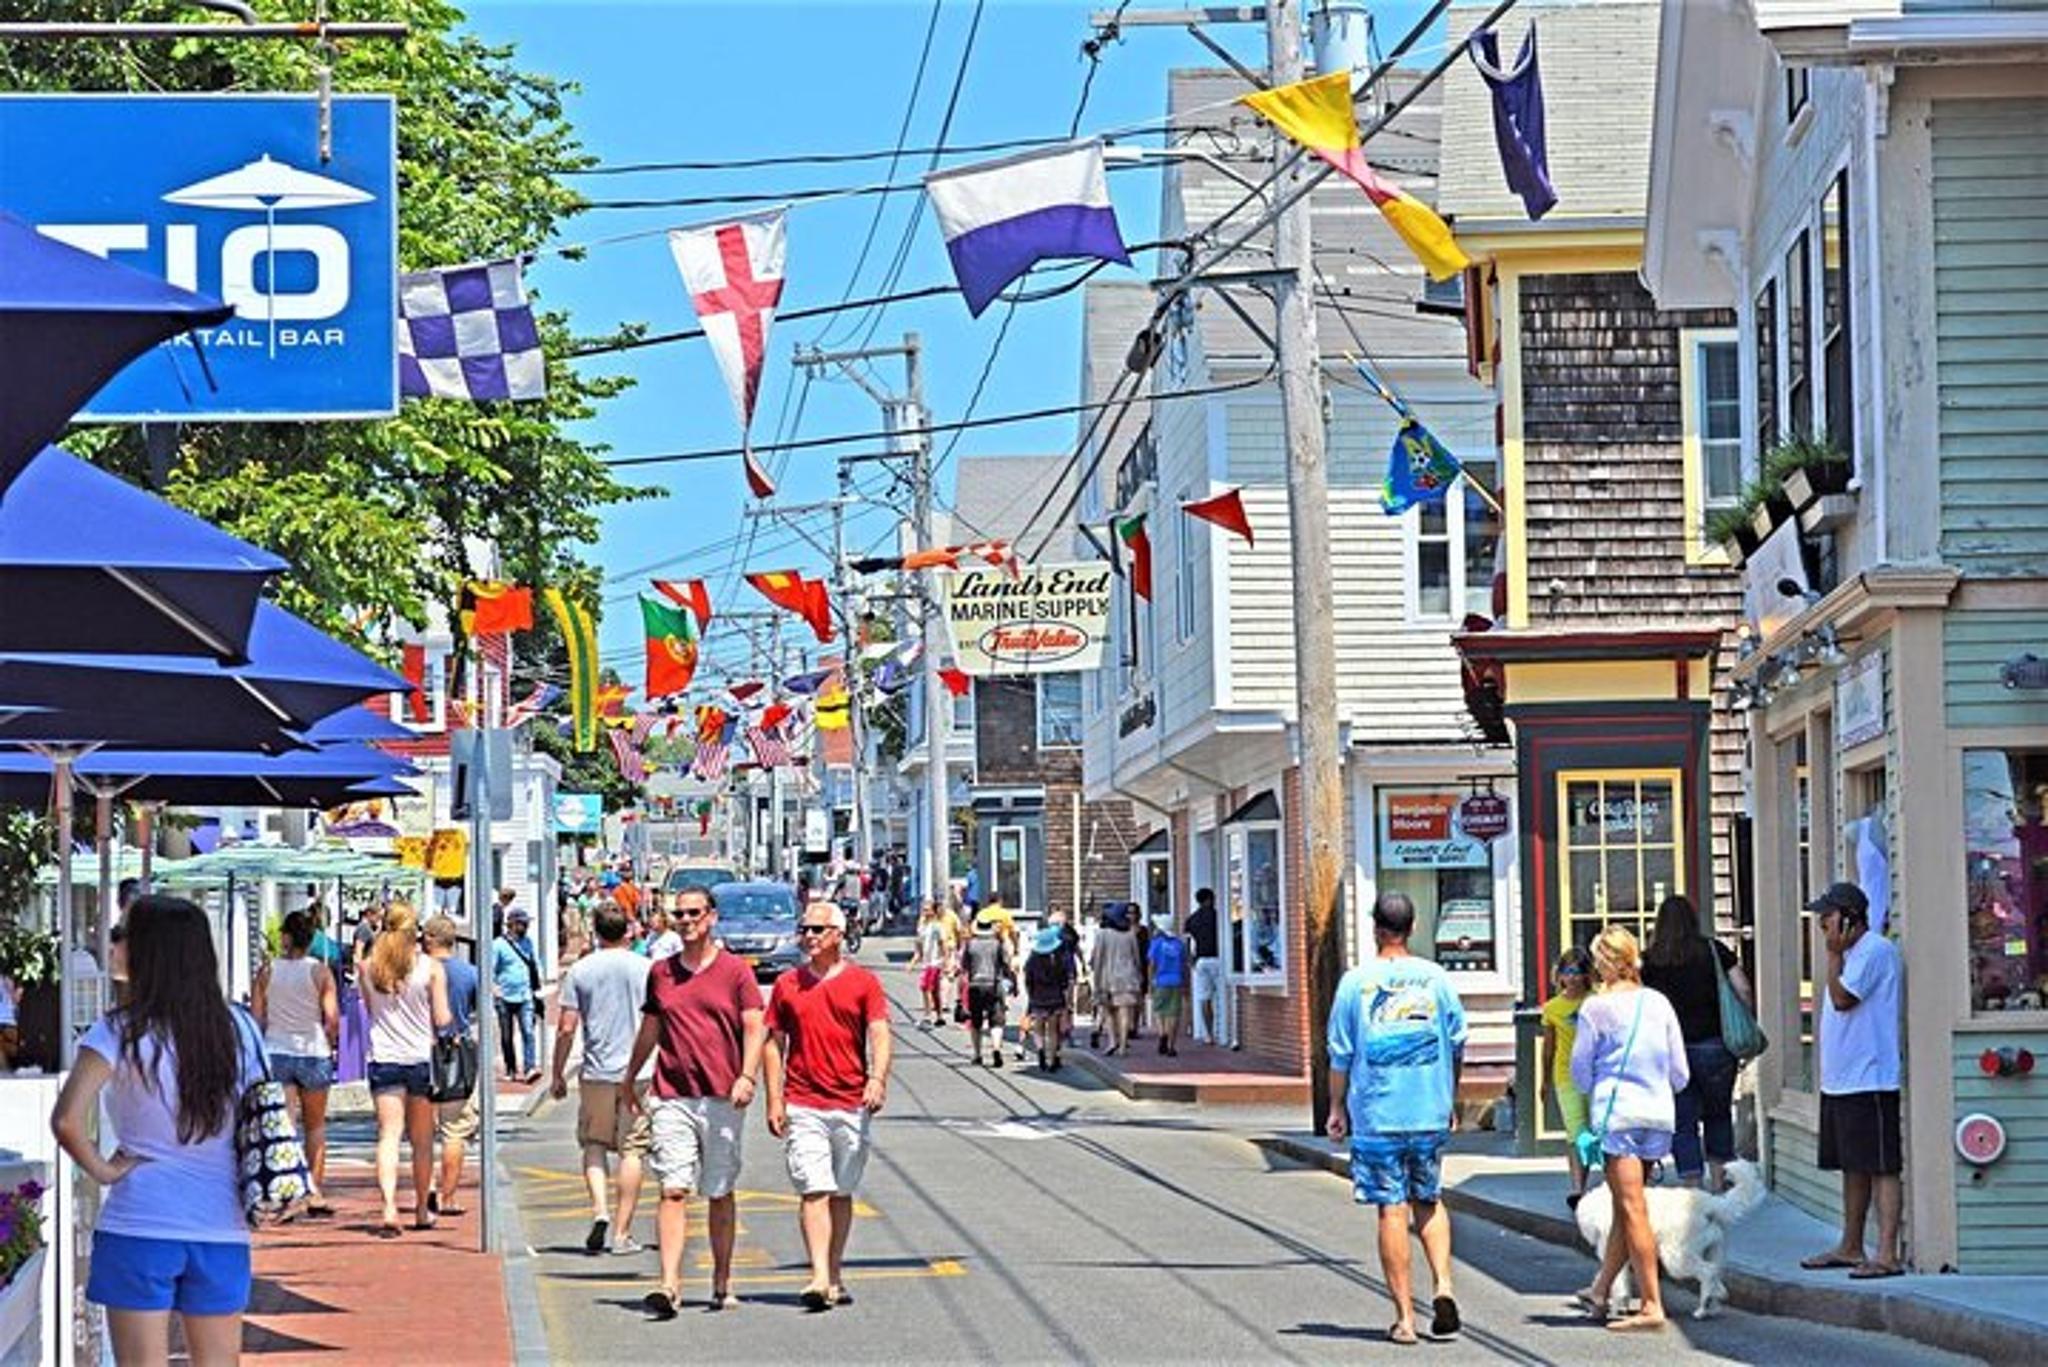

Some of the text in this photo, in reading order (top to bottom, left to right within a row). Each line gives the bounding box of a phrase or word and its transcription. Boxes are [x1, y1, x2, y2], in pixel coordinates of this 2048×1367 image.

[279, 329, 345, 346] BAR
[951, 568, 1110, 599] Lands End
[950, 597, 1109, 621] MARINE SUPPLY
[1392, 803, 1448, 818] Benjamin
[1392, 819, 1432, 831] Moore
